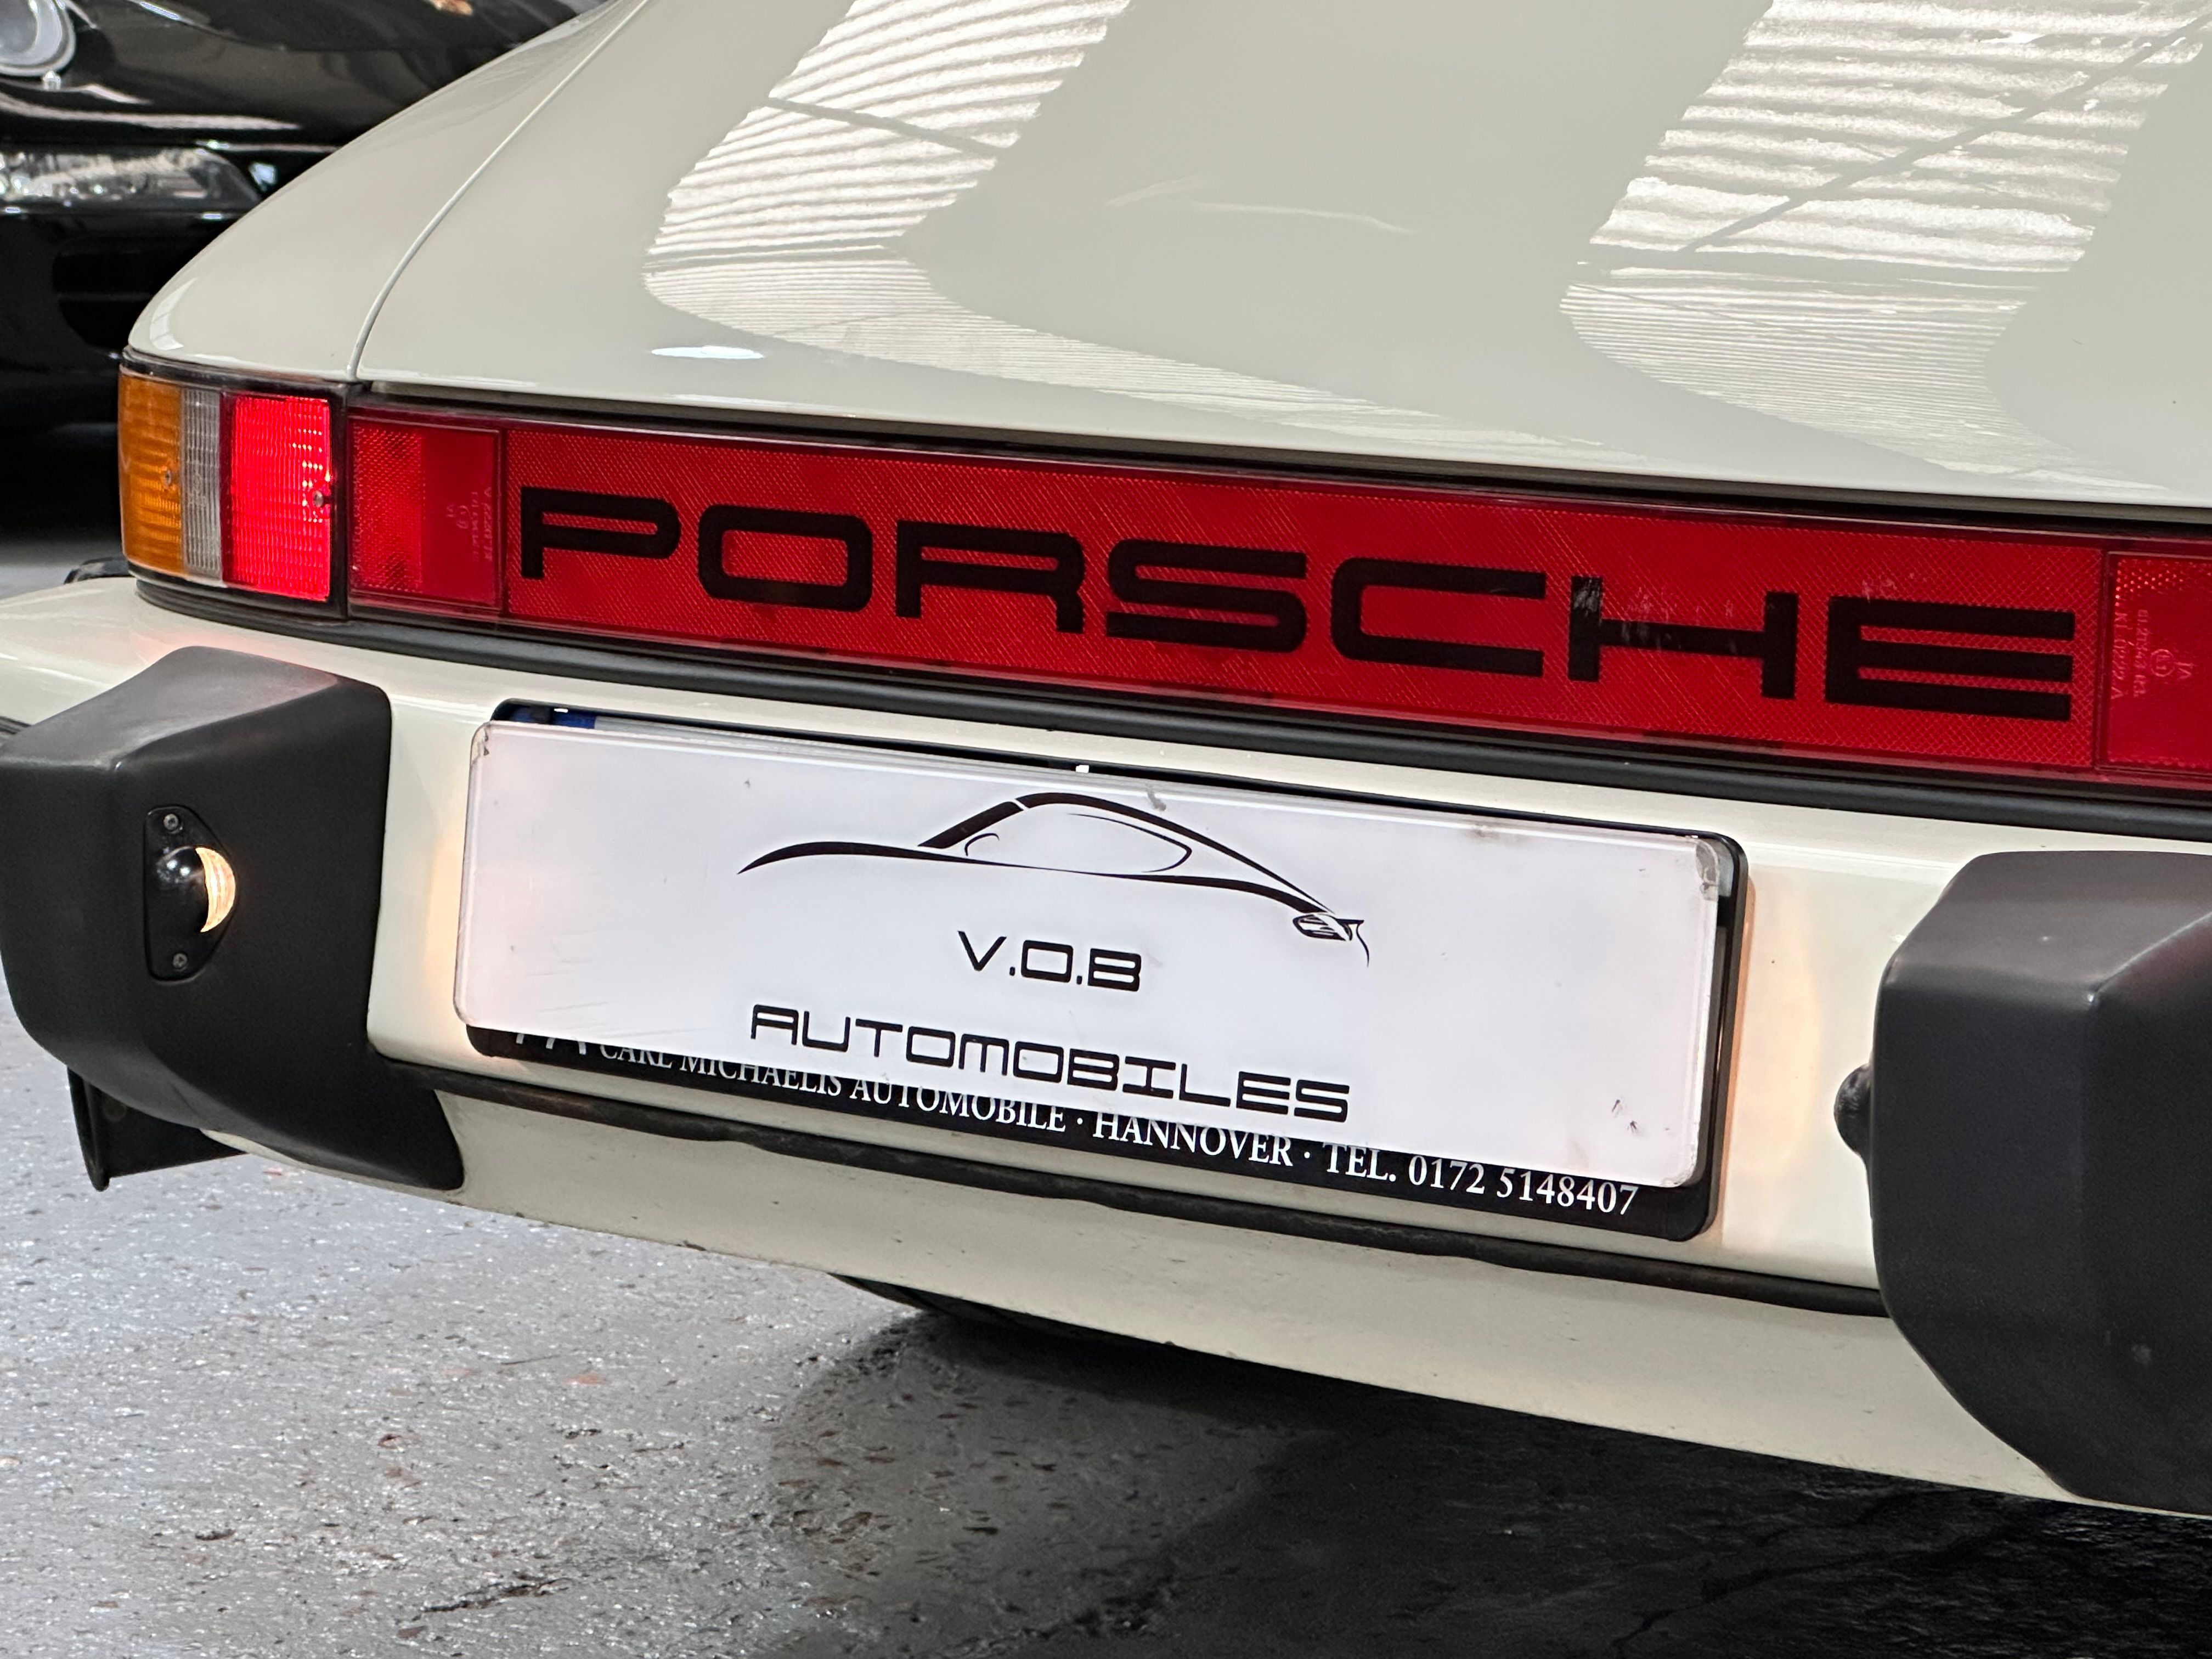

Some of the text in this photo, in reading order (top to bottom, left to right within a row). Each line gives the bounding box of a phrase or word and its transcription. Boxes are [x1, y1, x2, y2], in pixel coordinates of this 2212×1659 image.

[520, 486, 2076, 722] PORSCHE
[957, 931, 1142, 991] V.O.B
[750, 1004, 1350, 1123] AUTOMOBILES
[679, 1056, 842, 1097] MICHAELIS
[849, 1079, 1066, 1132] AUTOMOBILE
[1092, 1113, 1294, 1167] HANNOVER
[1322, 1142, 1397, 1182] TEL.
[1408, 1155, 1485, 1195] 0172
[1496, 1168, 1640, 1216] 5148407
